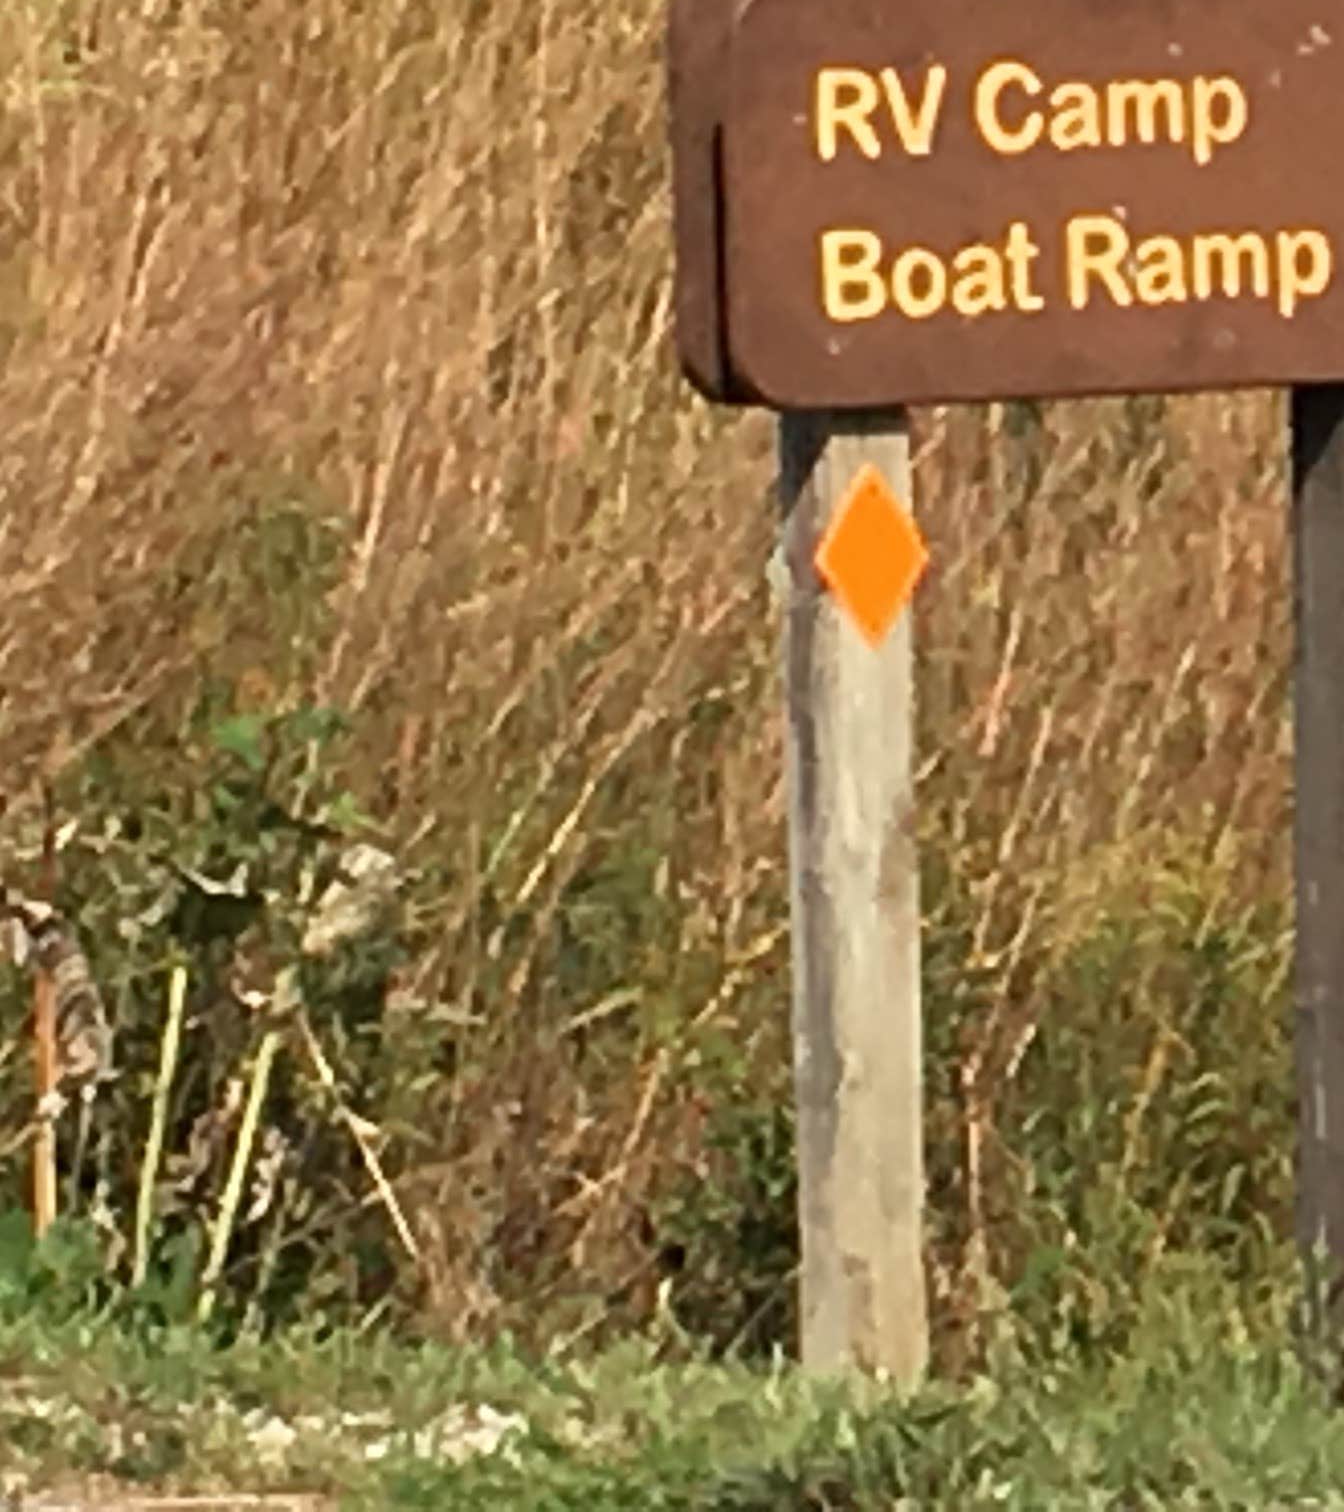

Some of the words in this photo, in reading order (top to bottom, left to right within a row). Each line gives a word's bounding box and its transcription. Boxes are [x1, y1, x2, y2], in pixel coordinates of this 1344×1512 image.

[814, 64, 948, 162] RV
[974, 61, 1248, 167] Camp
[820, 221, 1046, 322] Boat
[1065, 214, 1332, 319] Ramp
